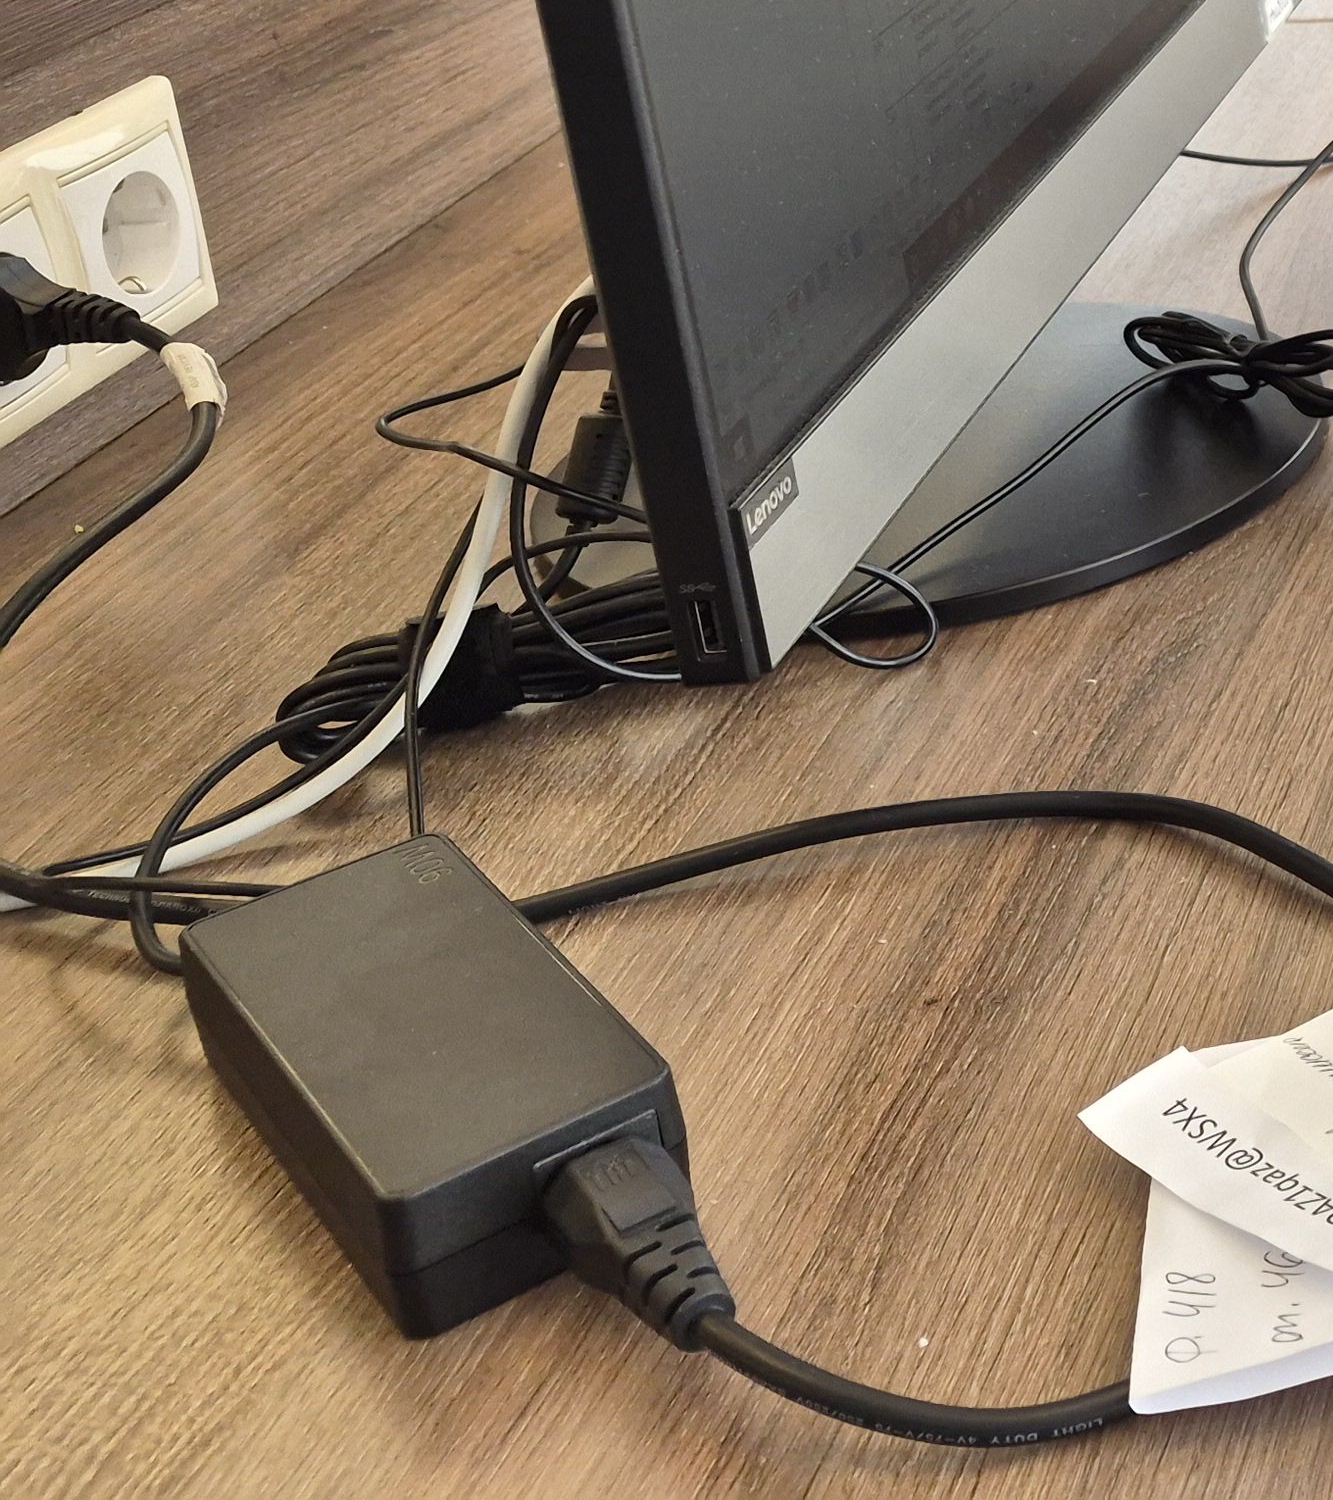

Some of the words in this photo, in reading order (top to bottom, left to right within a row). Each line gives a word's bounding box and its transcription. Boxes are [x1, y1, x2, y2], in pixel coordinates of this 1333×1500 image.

[746, 475, 792, 535] Lenovo
[1163, 1271, 1217, 1317] 418
[990, 1432, 1039, 1445] DUTY
[1052, 1417, 1103, 1437] LIGHT
